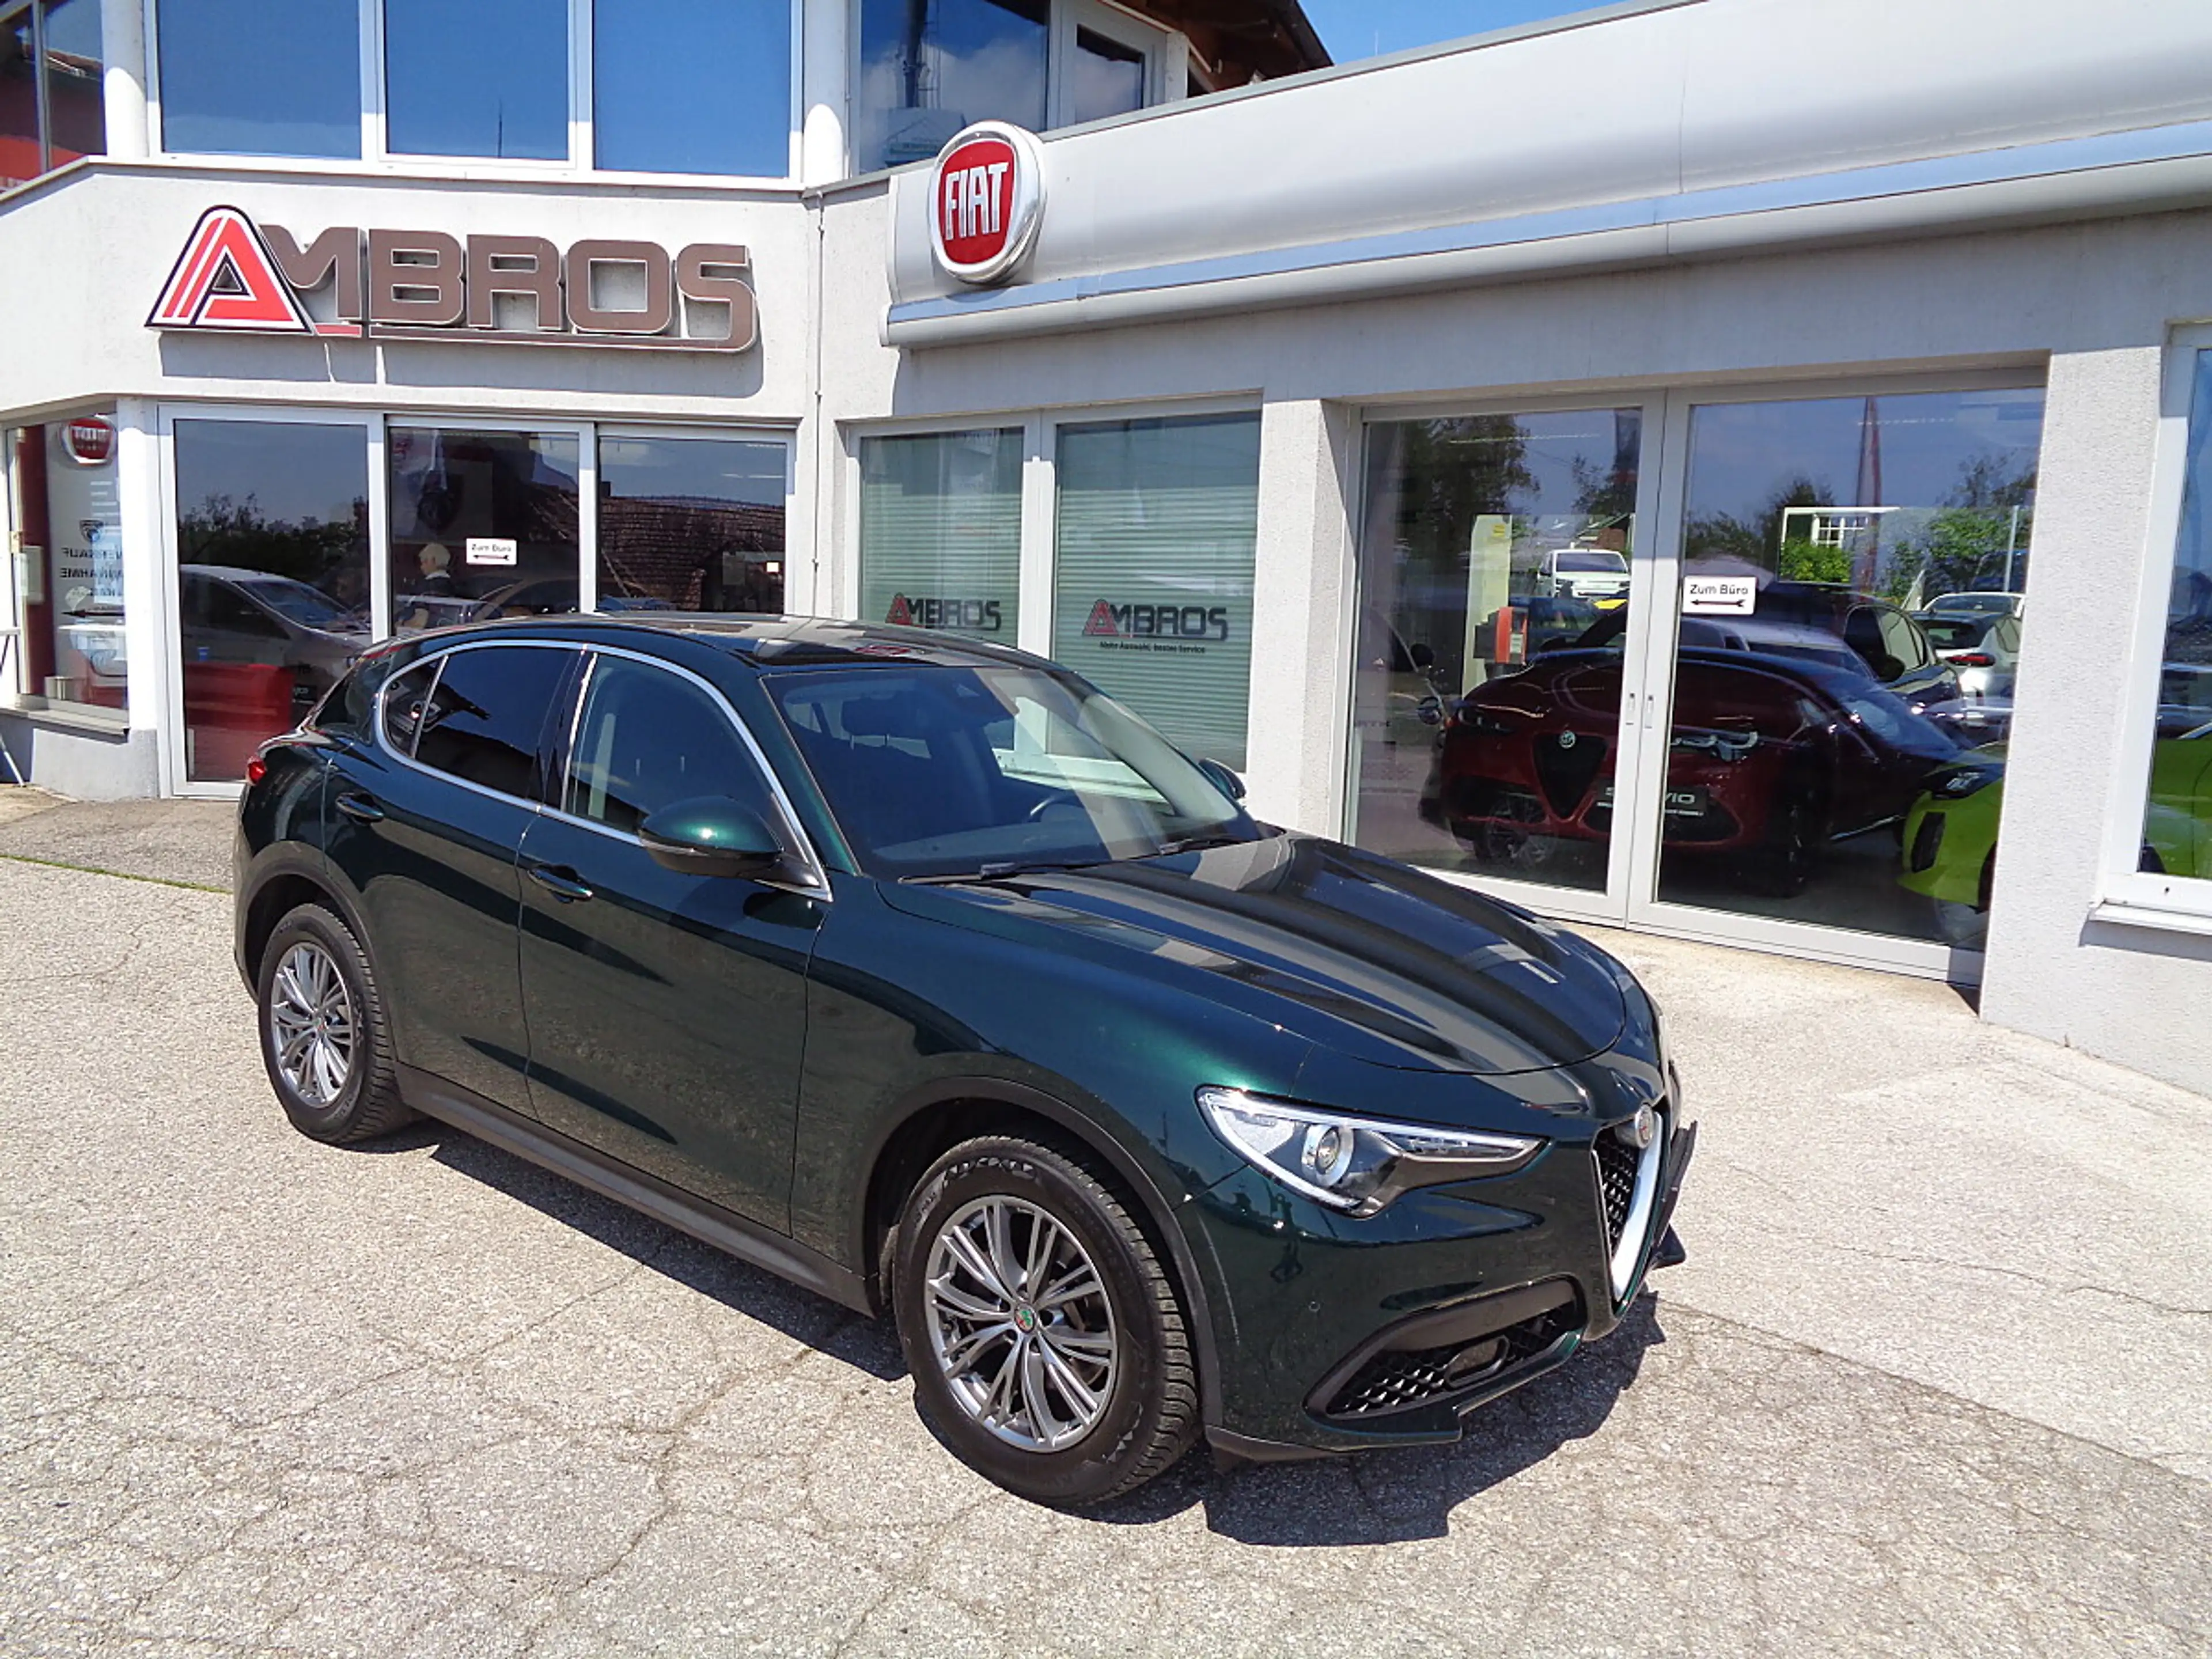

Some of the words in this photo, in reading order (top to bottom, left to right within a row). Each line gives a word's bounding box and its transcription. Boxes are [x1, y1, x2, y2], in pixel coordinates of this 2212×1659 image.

[945, 162, 1009, 241] FIAT
[144, 204, 756, 352] AMBROS
[1690, 584, 1717, 594] Zum
[1719, 584, 1749, 595] Büro
[885, 592, 1002, 631] AMBROS
[1082, 599, 1228, 641] AMBROS
